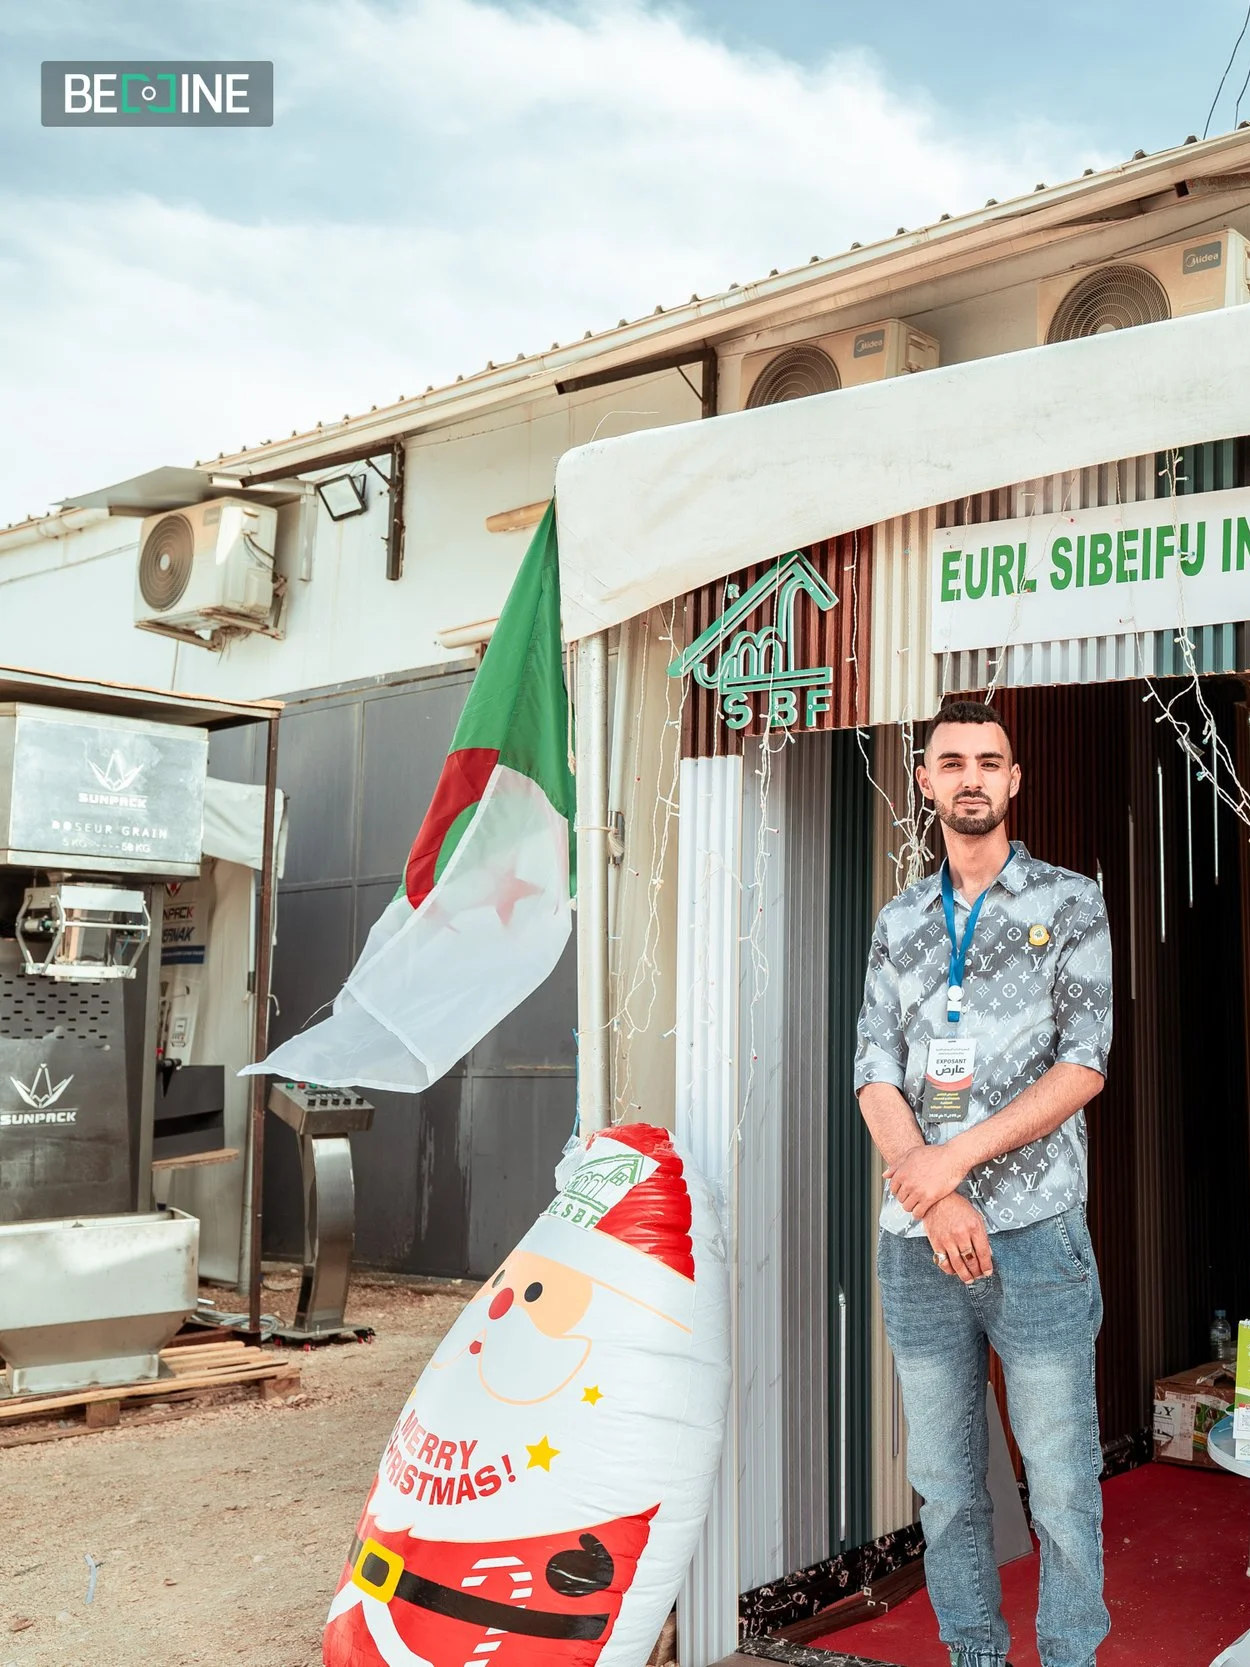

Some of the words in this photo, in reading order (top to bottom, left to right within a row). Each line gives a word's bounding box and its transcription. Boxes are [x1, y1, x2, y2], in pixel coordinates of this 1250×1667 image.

[1185, 253, 1219, 268] Midea
[940, 542, 1037, 603] EURL
[1049, 520, 1207, 591] SIBEIFU
[121, 825, 168, 839] GRAIN
[135, 843, 151, 854] KG
[935, 1064, 965, 1077] عارض
[0, 1111, 77, 1126] SUNPACK
[401, 1408, 479, 1472] MERRY
